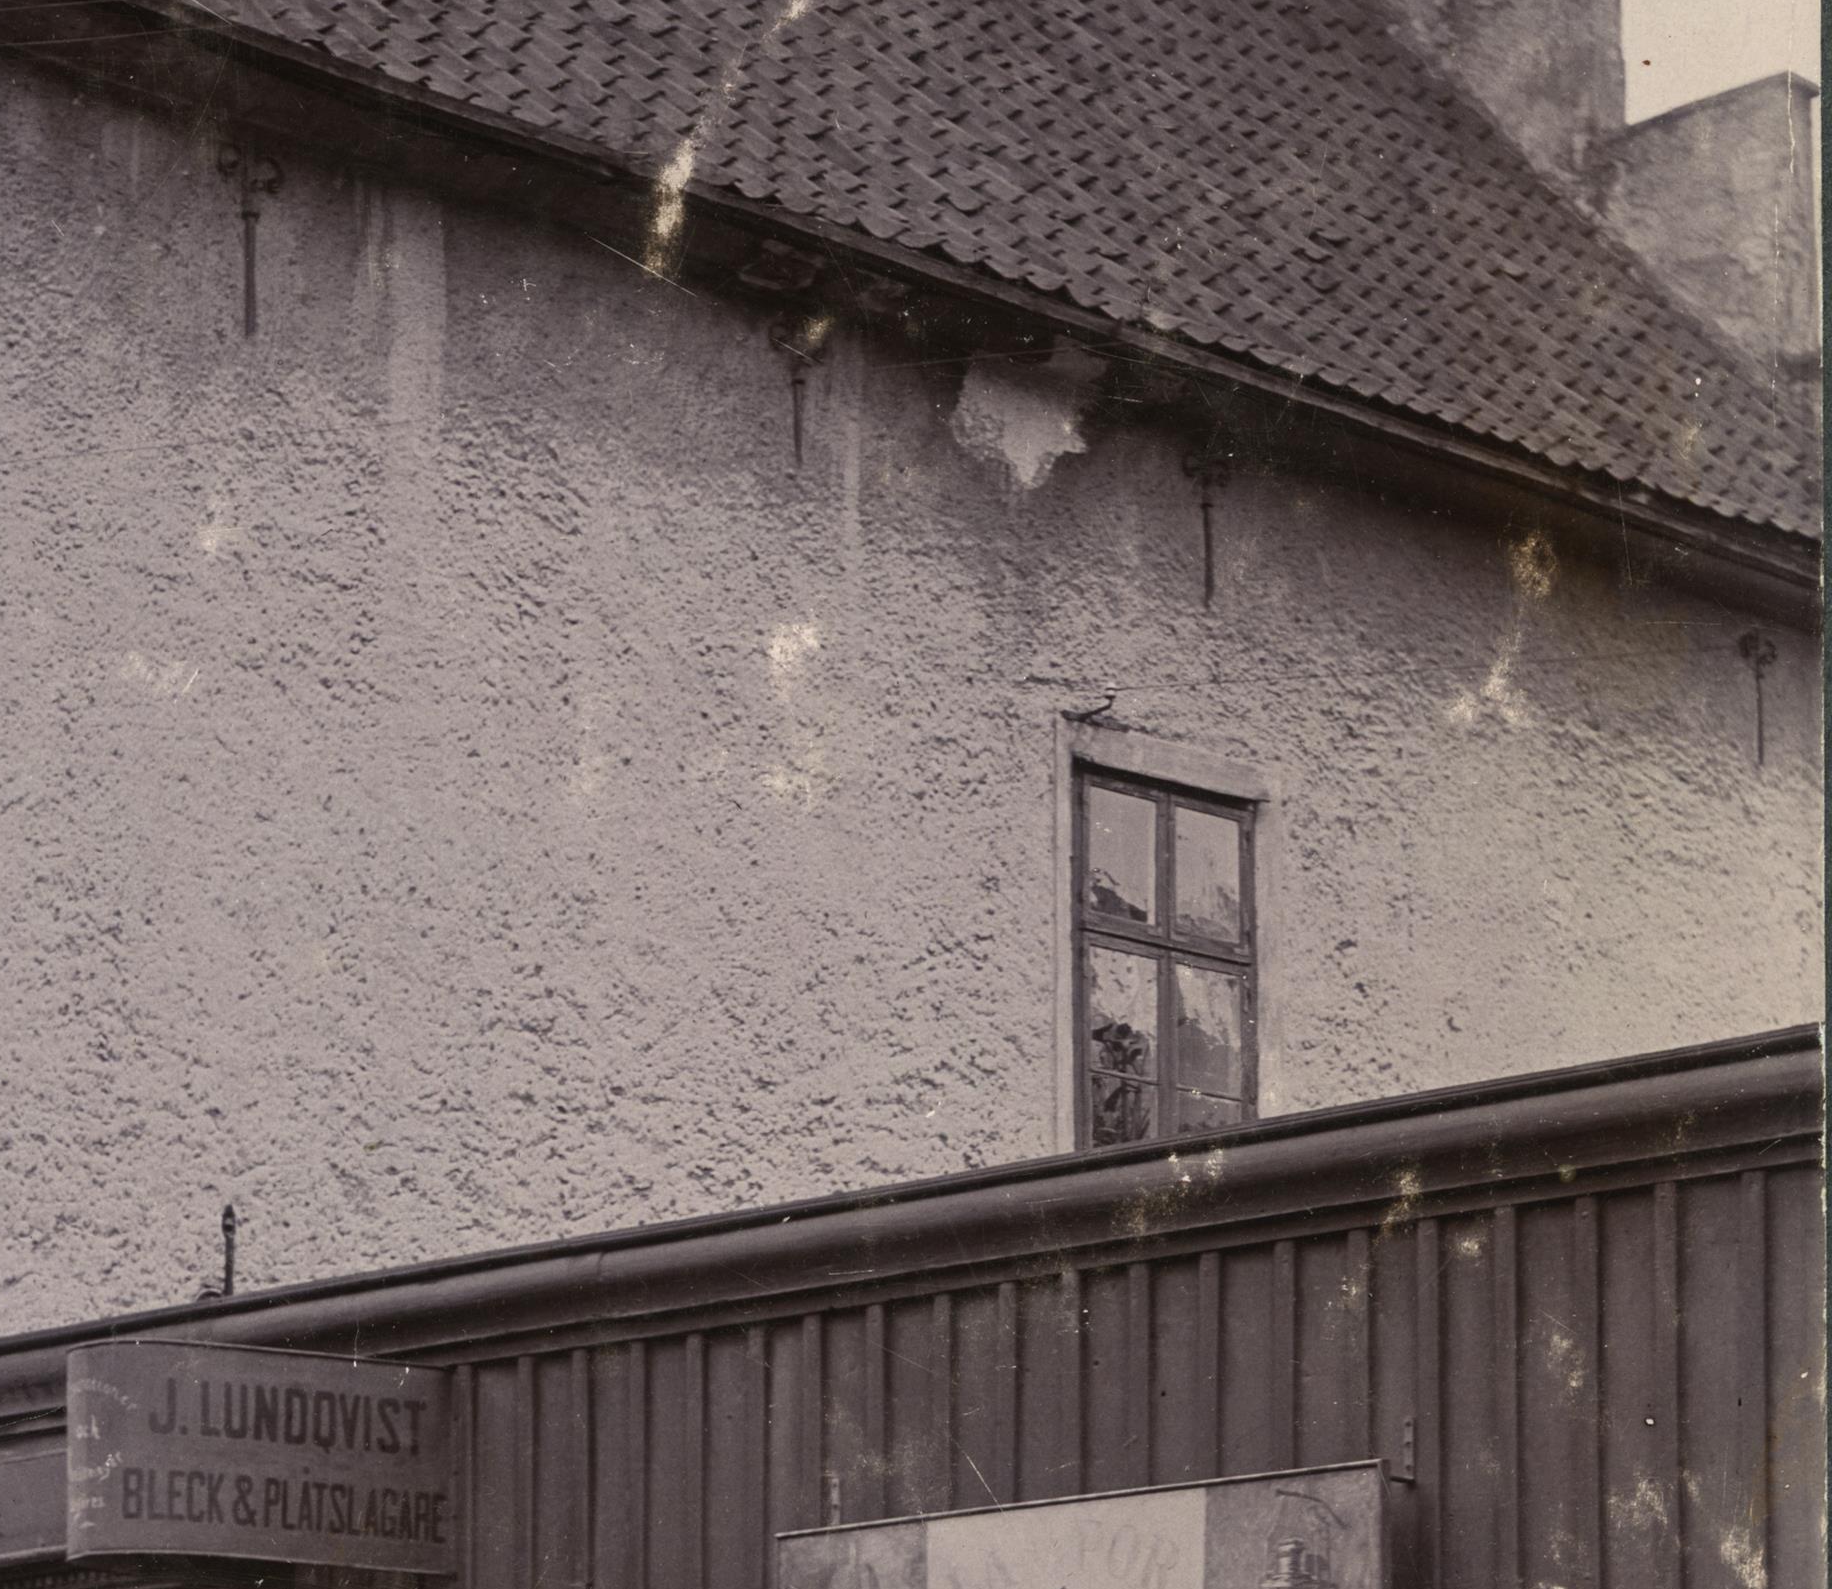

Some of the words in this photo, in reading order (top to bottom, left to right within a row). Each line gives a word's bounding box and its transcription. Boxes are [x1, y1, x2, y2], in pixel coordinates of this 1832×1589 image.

[147, 1377, 189, 1437] J.
[198, 1378, 428, 1457] LUNDQVIST
[120, 1466, 226, 1525] BLECK
[231, 1473, 257, 1528] &
[262, 1465, 450, 1545] PLÅTSLAGARE
